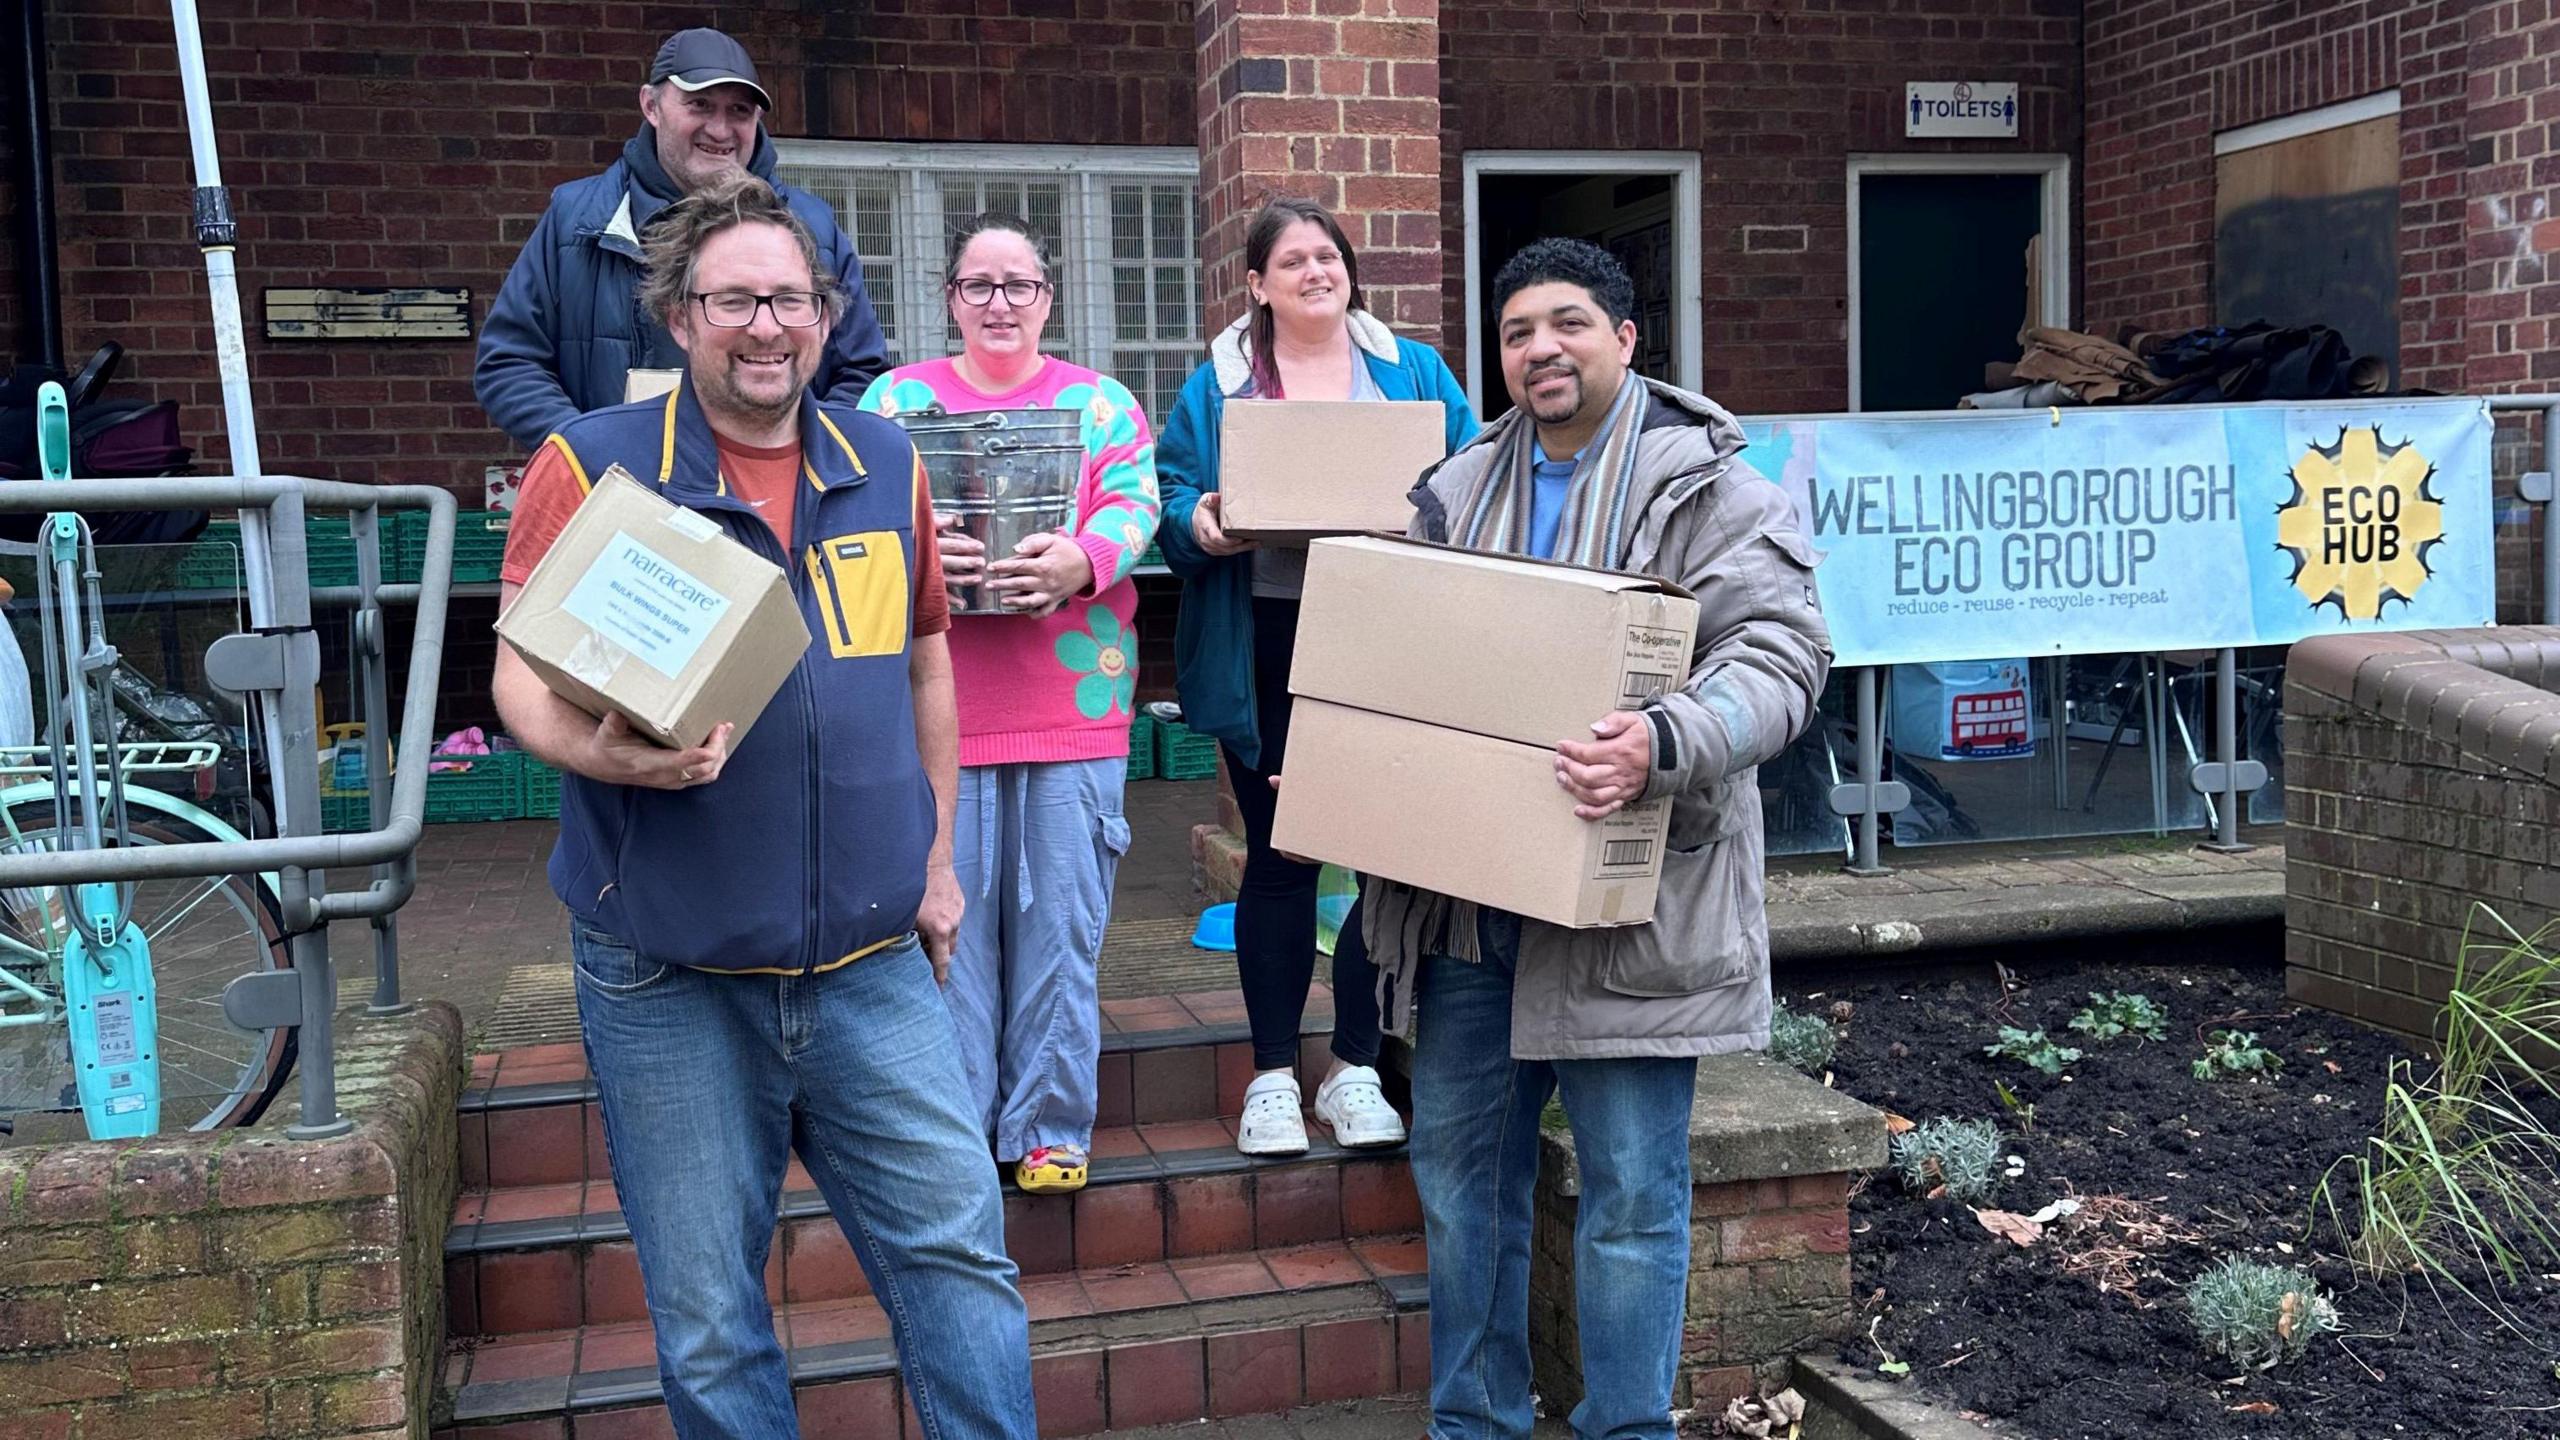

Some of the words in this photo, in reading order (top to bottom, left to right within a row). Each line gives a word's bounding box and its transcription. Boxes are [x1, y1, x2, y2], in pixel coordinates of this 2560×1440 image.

[1925, 100, 2002, 118] TOILETS
[1808, 464, 2235, 536] WELLINGBOROUGH
[2323, 485, 2400, 525] ECO
[1895, 535, 1981, 596] ECO
[2002, 528, 2156, 592] GROUP
[2323, 524, 2400, 565] HUB
[609, 580, 634, 600] BULK
[633, 595, 662, 617] WINGS
[661, 613, 690, 635] SUPER
[1888, 598, 1949, 616] reduce
[1964, 596, 2015, 612] reuse
[2029, 591, 2095, 612] recycle
[2109, 588, 2169, 608] repeat
[1629, 631, 1641, 643] The
[1641, 632, 1682, 648] Co-operative
[98, 999, 121, 1009] Shark
